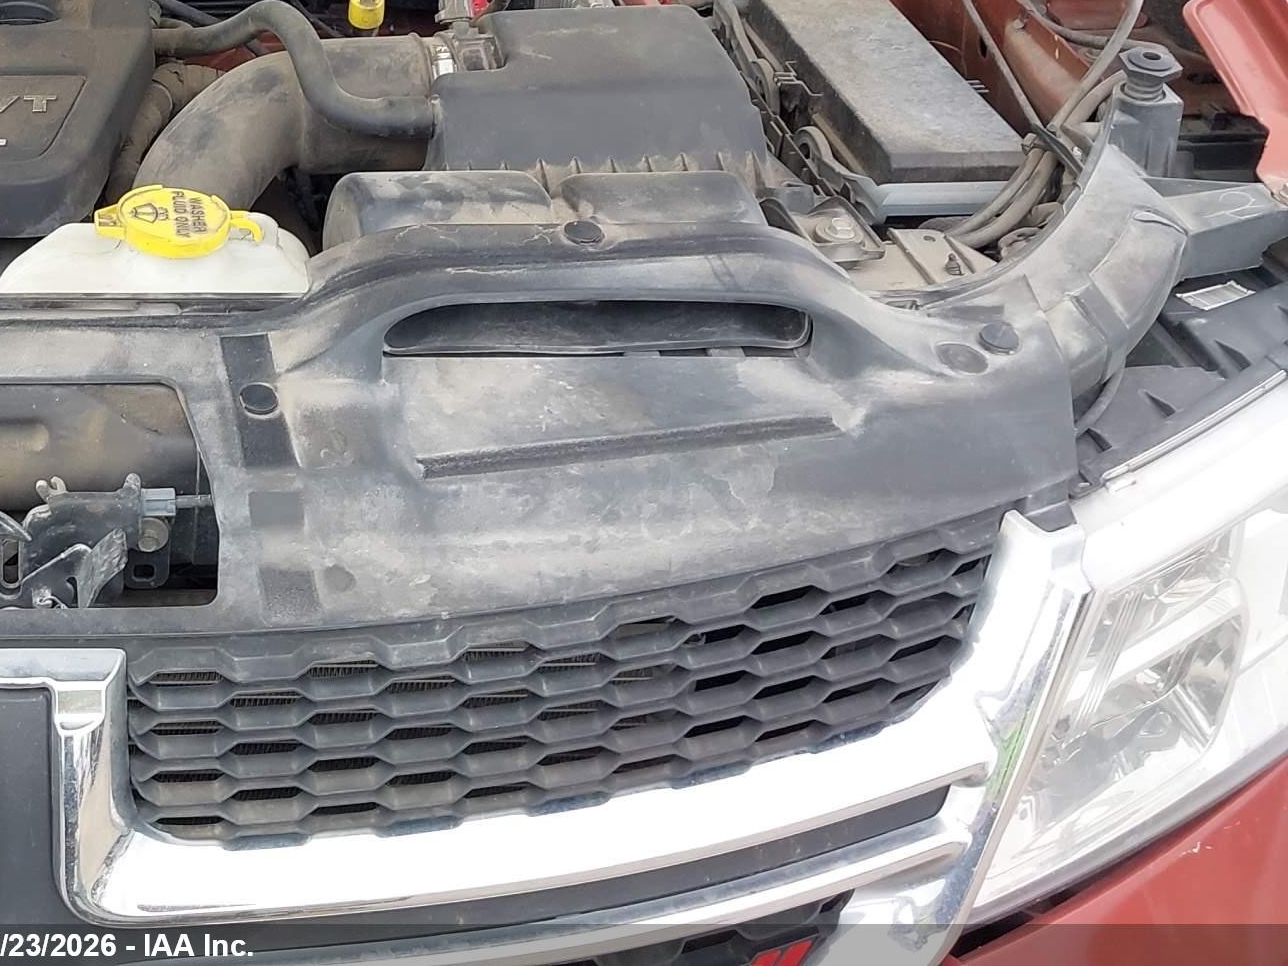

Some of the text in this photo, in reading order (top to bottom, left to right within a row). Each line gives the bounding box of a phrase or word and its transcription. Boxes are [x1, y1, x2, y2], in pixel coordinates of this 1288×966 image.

[172, 190, 191, 238] FLUID ONLY
[189, 196, 207, 233] WASHER
